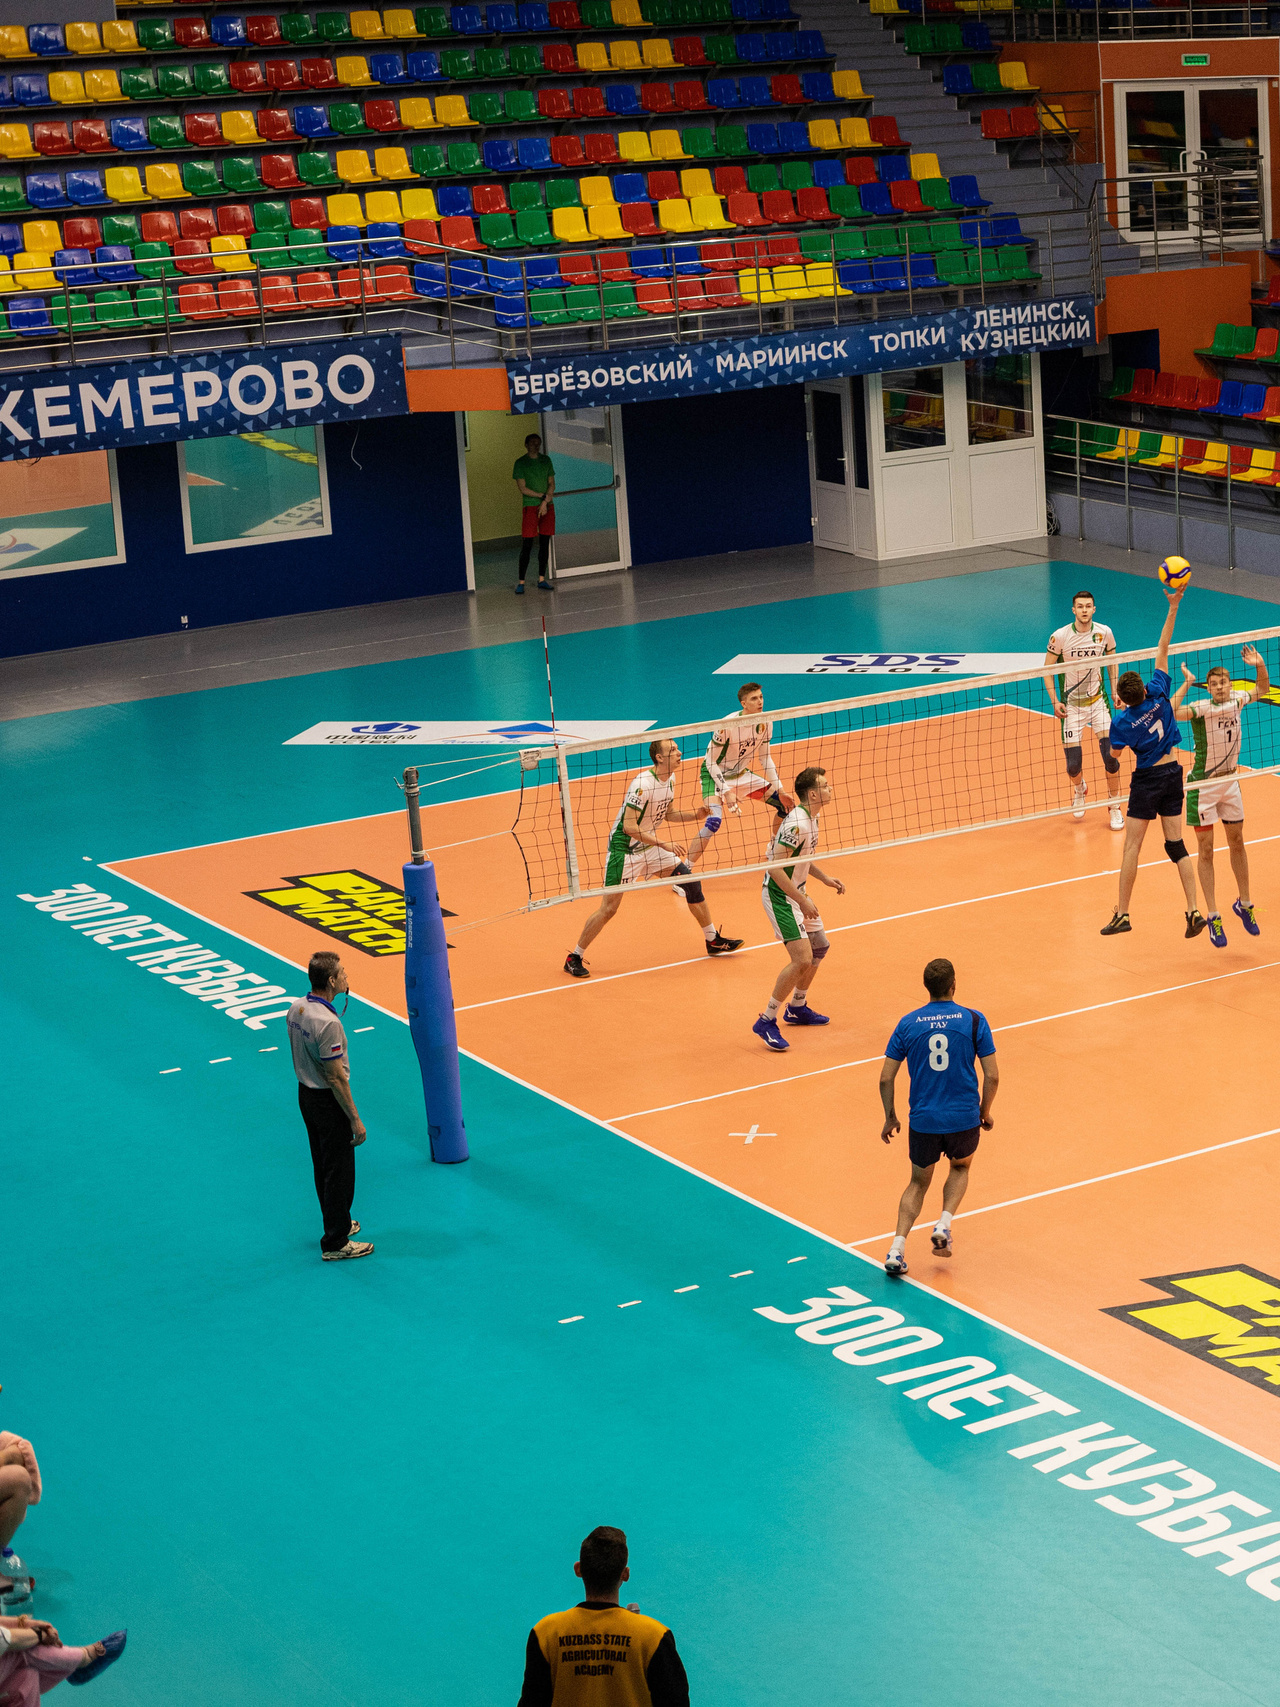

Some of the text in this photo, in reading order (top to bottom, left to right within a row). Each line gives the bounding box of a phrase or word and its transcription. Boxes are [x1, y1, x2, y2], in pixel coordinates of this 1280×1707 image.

[974, 301, 1076, 330] ЛЕНИНСК
[960, 315, 1091, 353] КУЗНЕЦКИЙ
[513, 326, 946, 396] БЕРЁЗОВСКИЙ МАРИИНСК ТОПКИ
[813, 654, 966, 667] SDS
[1065, 730, 1073, 739] 10
[1148, 719, 1164, 742] 7
[1226, 729, 1232, 743] 1
[1200, 813, 1205, 821] 1
[16, 883, 128, 921] 300
[70, 915, 188, 950] ЛЕТ
[916, 1012, 962, 1023] Алтайский
[929, 1033, 949, 1071] 8
[752, 1285, 943, 1366] 300
[876, 1356, 1080, 1435] ЛЕТ
[559, 1634, 631, 1647] KUZBASS STATE
[562, 1650, 627, 1662] AGRICULTURAL
[575, 1665, 614, 1676] ACADEMY
